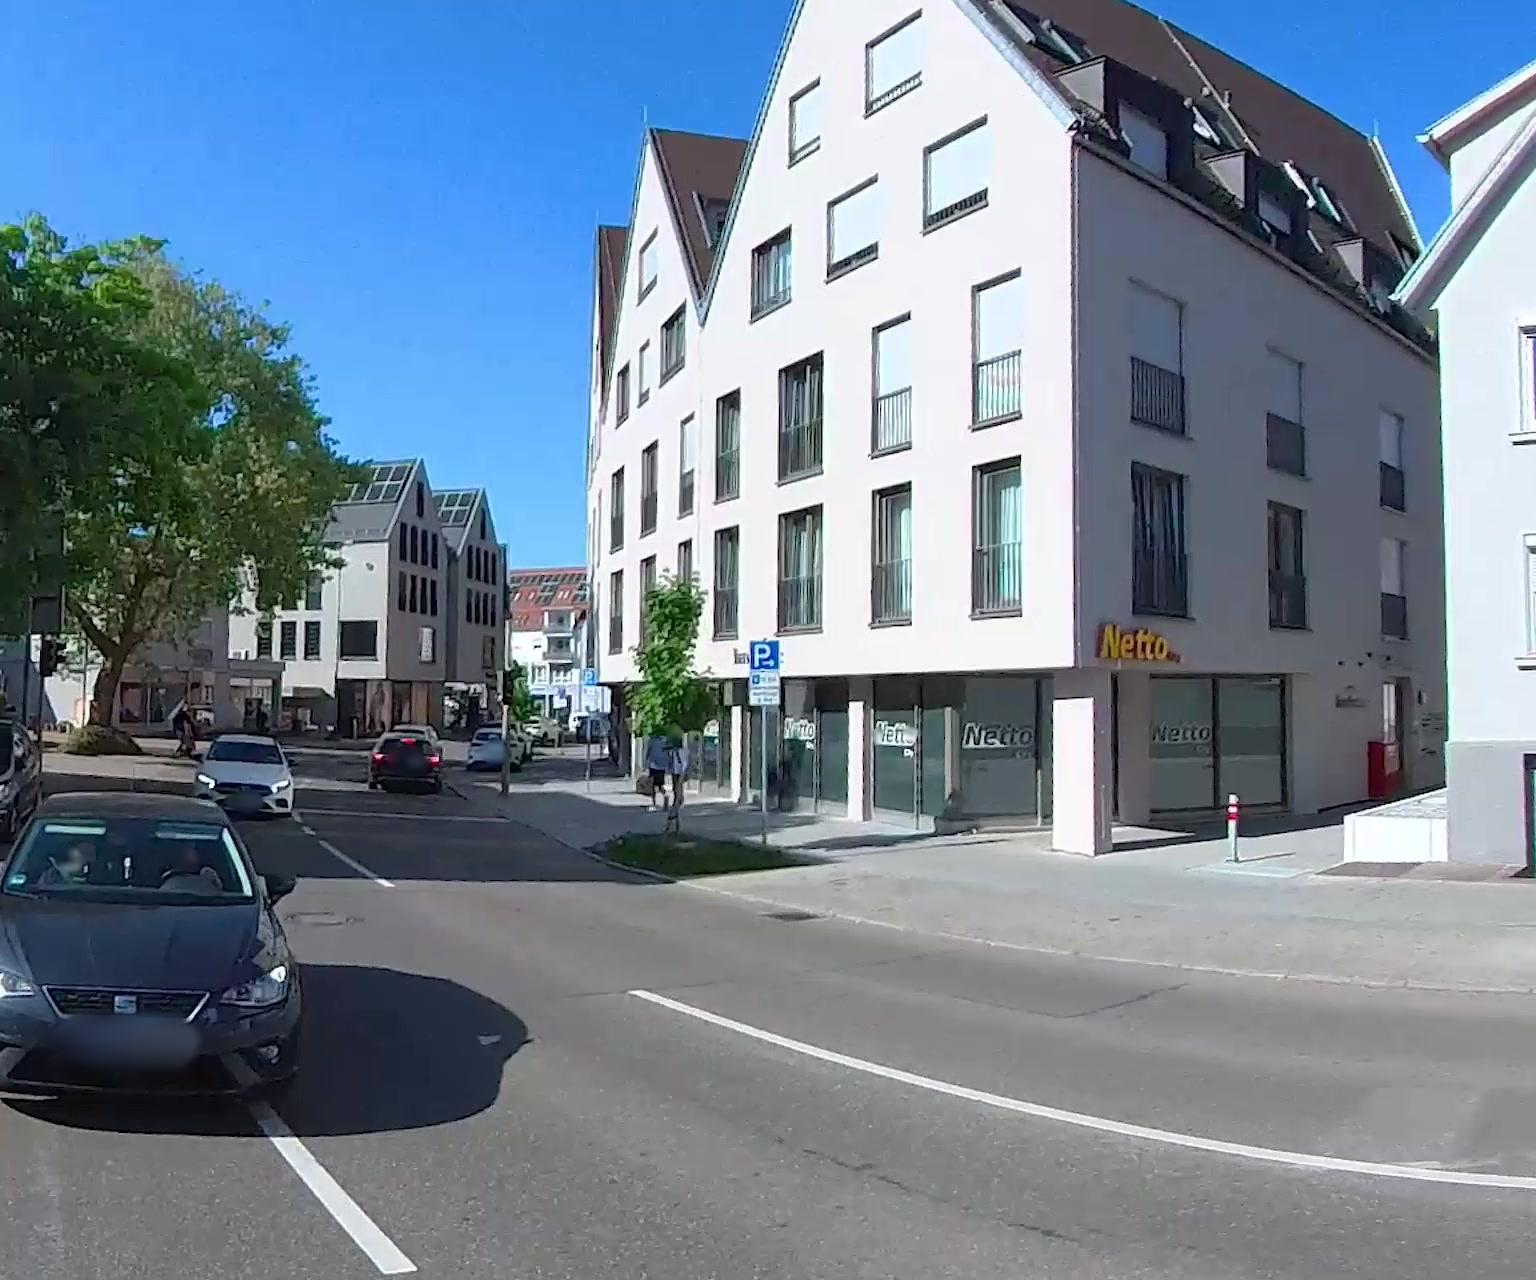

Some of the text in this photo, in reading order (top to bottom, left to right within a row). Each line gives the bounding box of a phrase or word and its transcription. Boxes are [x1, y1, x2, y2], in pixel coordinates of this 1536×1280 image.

[1100, 623, 1168, 661] Netto
[753, 643, 772, 668] P
[962, 723, 1033, 748] Netto
[1152, 721, 1211, 743] Netto
